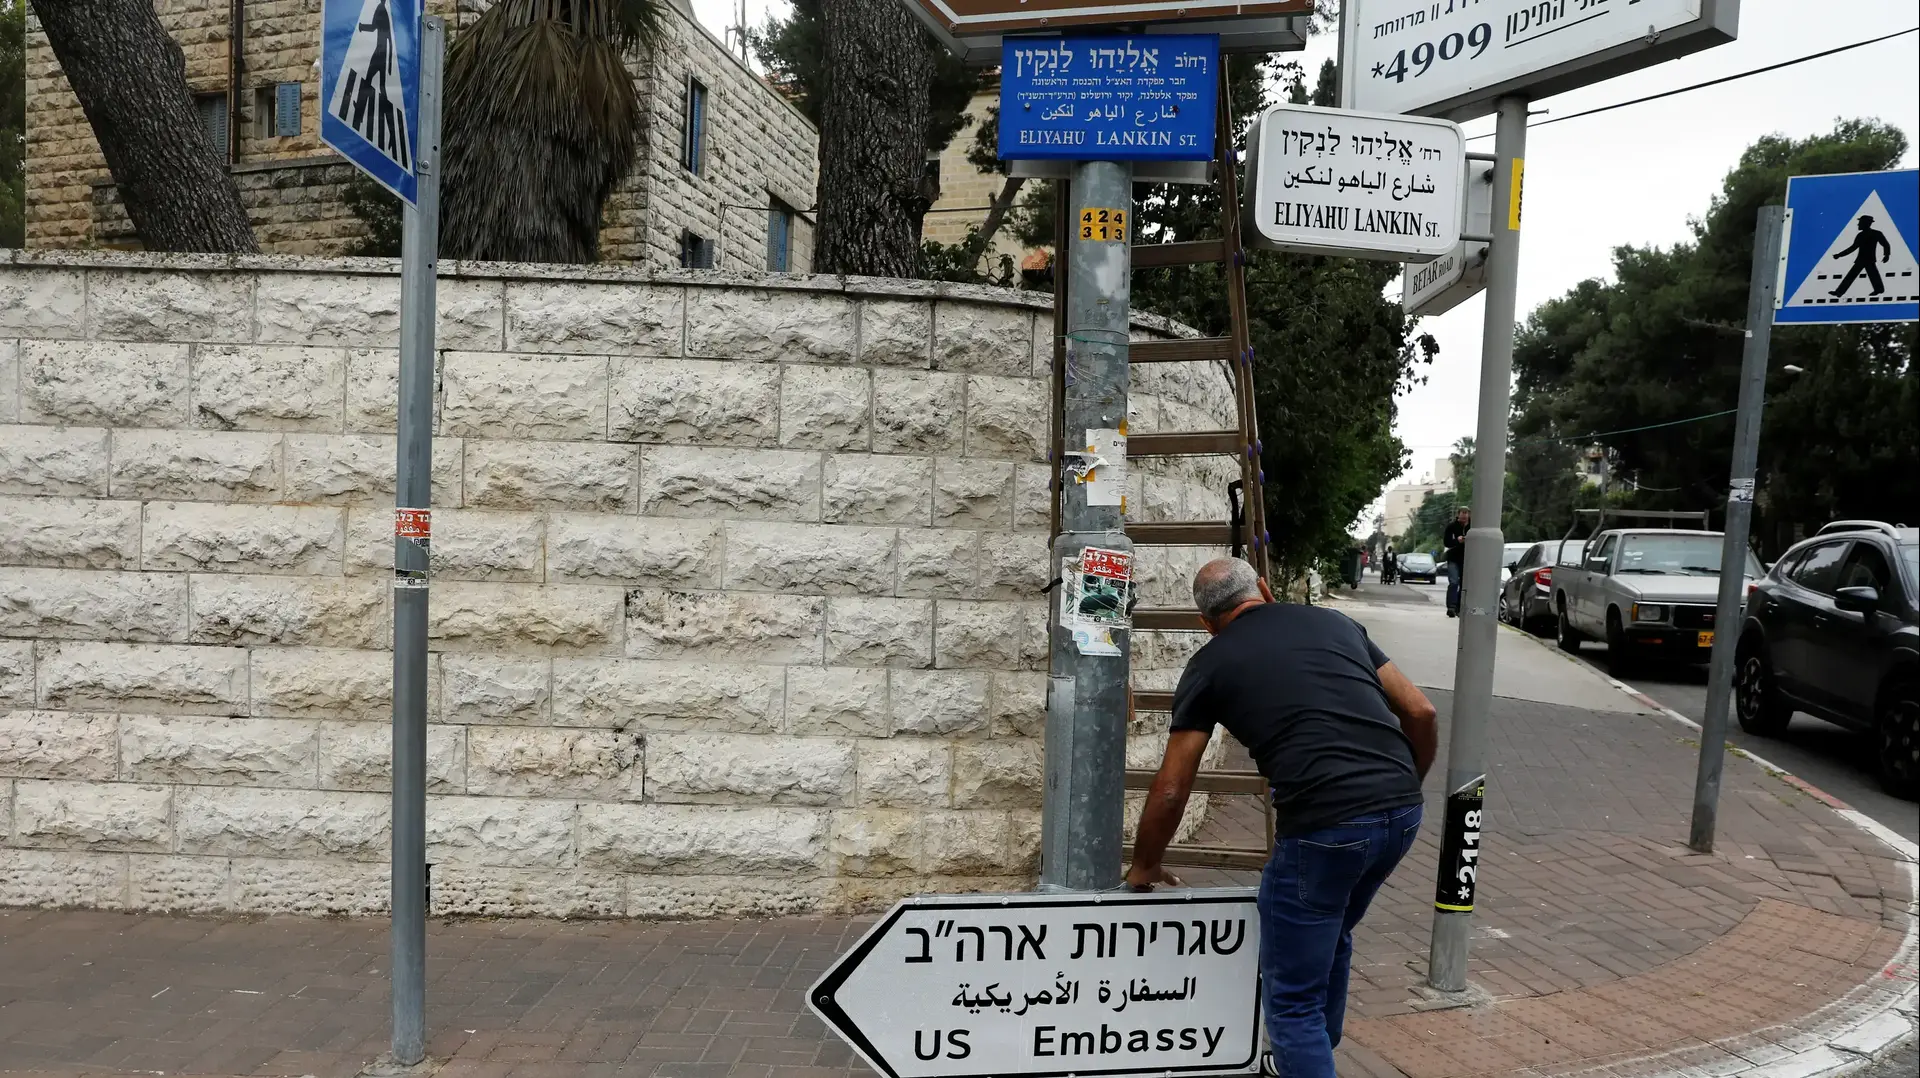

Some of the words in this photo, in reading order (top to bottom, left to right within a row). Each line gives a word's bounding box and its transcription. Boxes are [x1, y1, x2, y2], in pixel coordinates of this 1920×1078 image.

[1373, 10, 1425, 39] מרווחת
[1031, 77, 1068, 86] הראשונה
[1072, 77, 1101, 86] והכנסת
[1137, 77, 1165, 86] מפקדת
[1169, 77, 1186, 85] חבר
[1080, 89, 1112, 99] ירושלים
[1117, 91, 1133, 101] יקיר
[1176, 91, 1197, 101] מפקד
[1041, 103, 1074, 121] لنكين
[1135, 104, 1177, 126] شارع
[1019, 130, 1086, 145] ELIYAHU
[1096, 131, 1172, 146] LANKIN
[1179, 134, 1197, 146] ST.
[1283, 165, 1333, 189] لنكين
[1391, 173, 1435, 201] شارع
[1273, 201, 1349, 231] ELIYAHU
[1354, 207, 1423, 237] LANKIN
[1425, 221, 1441, 238] ST.
[1412, 261, 1438, 295] BETAR
[1438, 256, 1454, 278] ROAD
[1070, 918, 1247, 960] שגרירות
[951, 970, 1079, 1015] الأمريكية
[1099, 976, 1197, 1012] السفارة
[913, 1028, 972, 1061] US
[1032, 1023, 1226, 1058] Embassy
